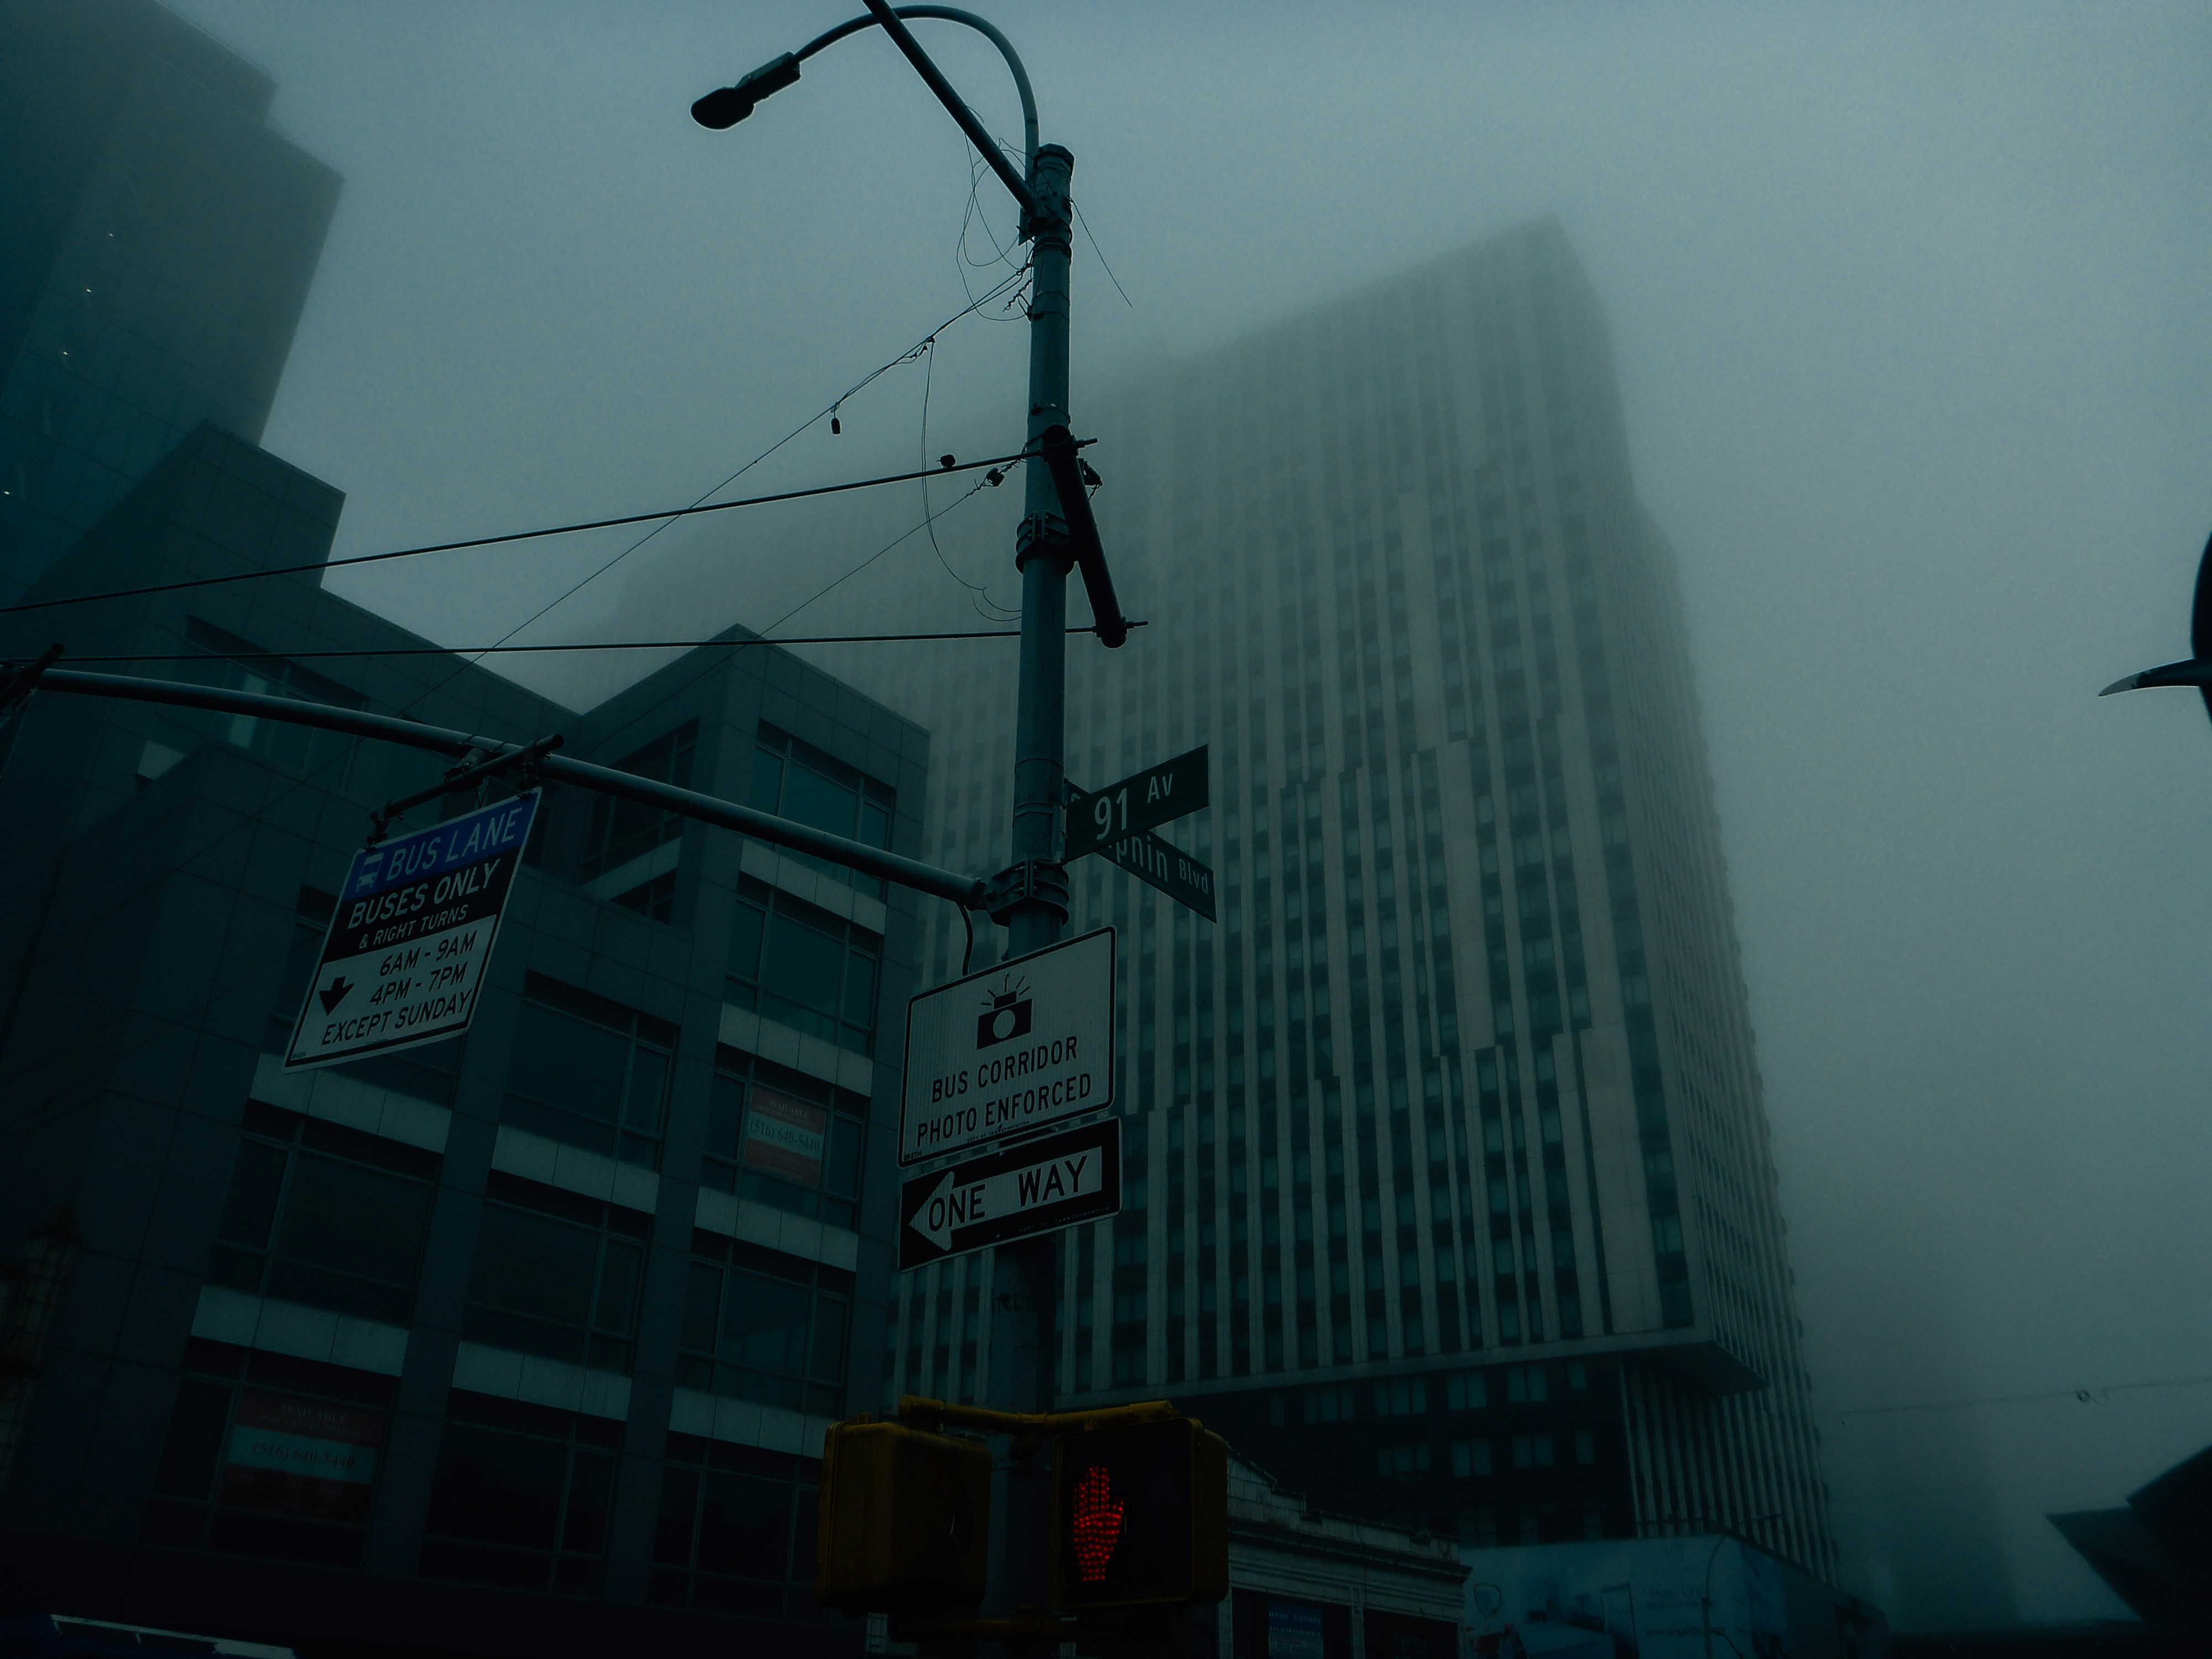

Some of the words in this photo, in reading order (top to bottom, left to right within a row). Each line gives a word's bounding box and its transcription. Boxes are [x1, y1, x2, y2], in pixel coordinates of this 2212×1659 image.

[1094, 787, 1127, 840] 91
[1147, 773, 1173, 804] Av
[385, 836, 441, 881] BUS
[446, 806, 523, 863] LANE
[347, 883, 429, 929] BUSES
[434, 858, 501, 902] ONLY
[1179, 858, 1208, 894] Blvd
[358, 932, 369, 949] &
[373, 919, 418, 947] RIGHT
[421, 904, 469, 934] TURNS
[379, 947, 421, 977] 6AM
[436, 930, 478, 962] 9AM
[369, 977, 413, 1006] 4PM
[428, 961, 468, 992] 7PM
[321, 1010, 393, 1045] EXCEPT
[395, 989, 472, 1029] SUNDAY
[932, 1071, 968, 1103] BUS
[978, 1036, 1077, 1088] CORRIDOR
[750, 1118, 774, 1139] (516)
[917, 1107, 977, 1147] PHOTO
[985, 1073, 1091, 1126] ENFORCED
[929, 1184, 985, 1232] ONE
[1018, 1155, 1088, 1207] WAY
[1055, 1206, 1110, 1223] TRANSPORTATION
[253, 1441, 289, 1460] (516)
